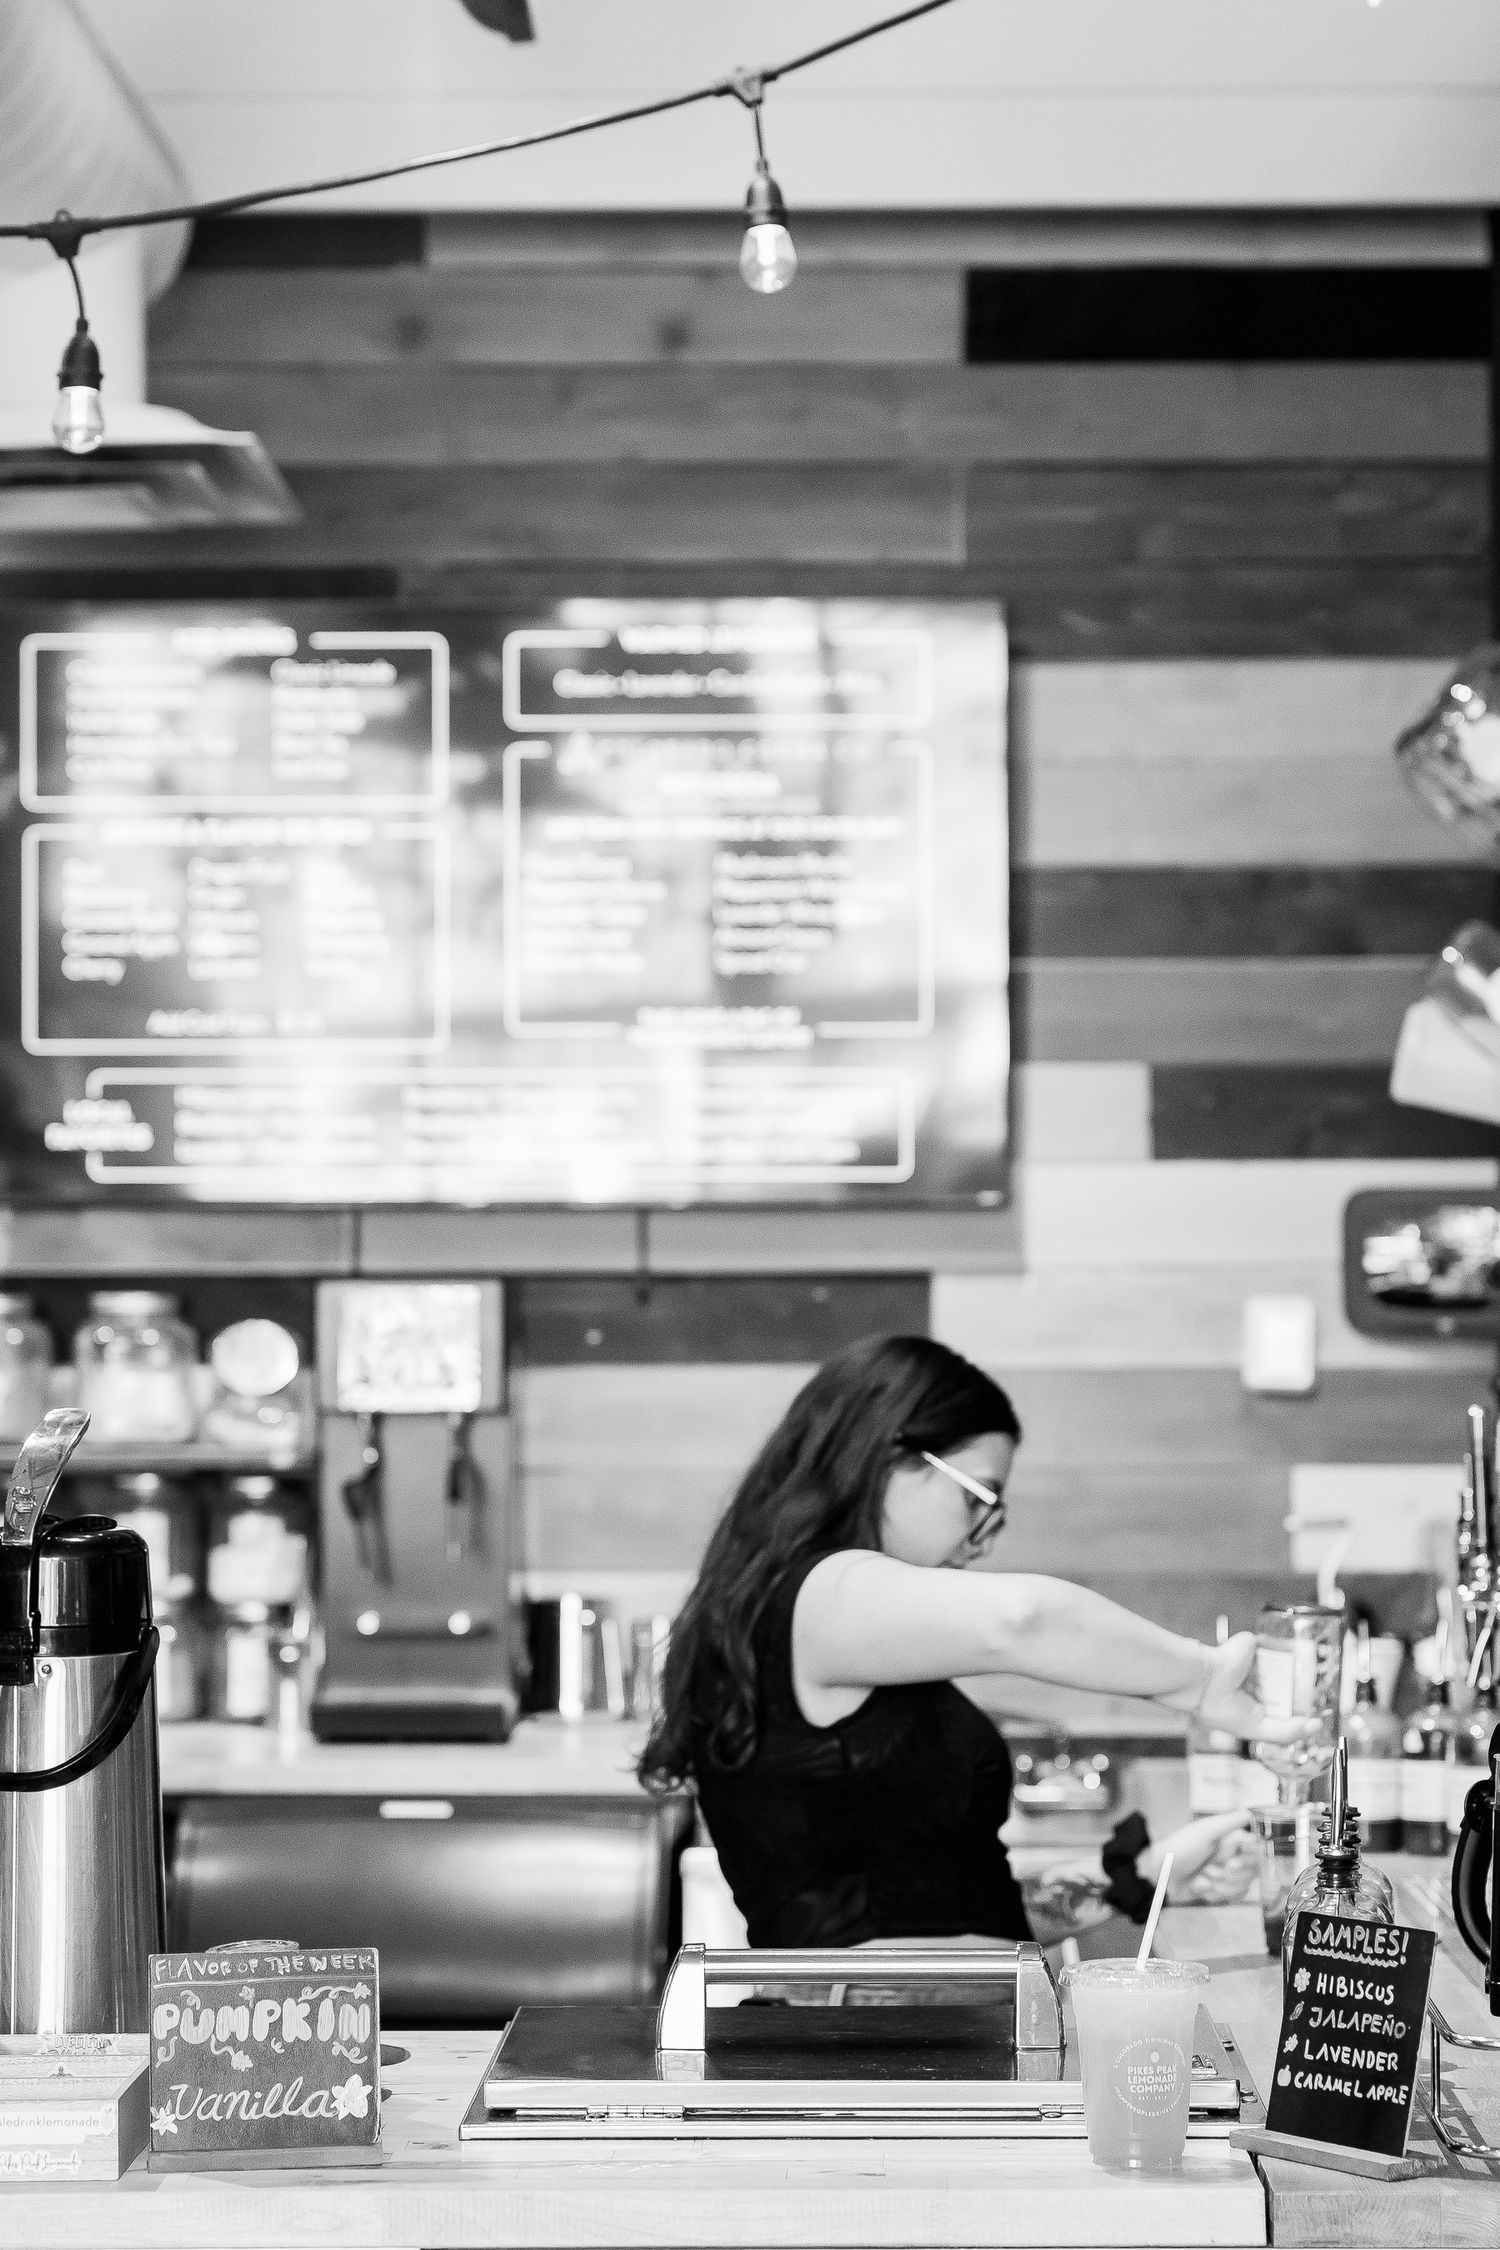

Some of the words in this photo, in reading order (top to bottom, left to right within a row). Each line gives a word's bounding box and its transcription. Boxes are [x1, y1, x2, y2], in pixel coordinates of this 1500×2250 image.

[1308, 1918, 1409, 1966] SAMPLES!
[155, 1957, 231, 1982] FLAVOR
[237, 1958, 259, 1974] OF
[264, 1955, 305, 1975] THE
[308, 1954, 375, 1973] WEEK
[1316, 1973, 1395, 2005] HIBISCUS
[153, 1998, 371, 2044] PUMPKIN
[1308, 2006, 1407, 2039] JALAPEÑO
[1127, 2066, 1155, 2075] PIKES
[1156, 2064, 1178, 2074] PEAK
[1303, 2039, 1399, 2072] LAVENDER
[1127, 2073, 1177, 2085] LEMONADE
[1129, 2083, 1176, 2094] COMPANY
[1294, 2071, 1363, 2098] CARAMEL
[1367, 2085, 1409, 2105] APPLE
[169, 2076, 338, 2121] Vanilla
